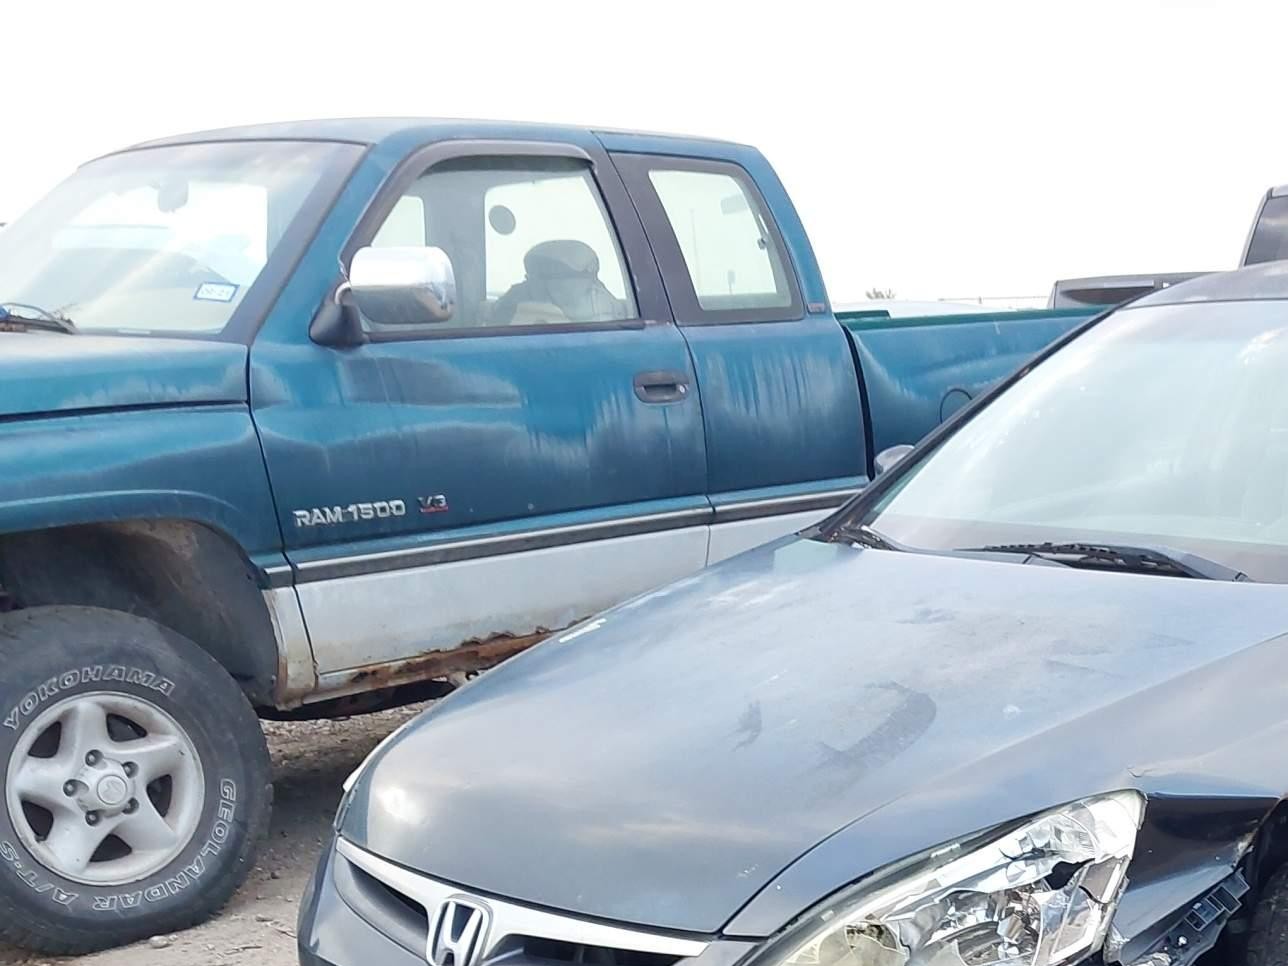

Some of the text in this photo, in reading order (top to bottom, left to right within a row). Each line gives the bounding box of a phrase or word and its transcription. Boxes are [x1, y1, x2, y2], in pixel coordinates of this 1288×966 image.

[293, 499, 406, 527] RAM 1500
[3, 664, 176, 731] YOKOHAMA
[92, 778, 237, 911] GEOLANDAR
